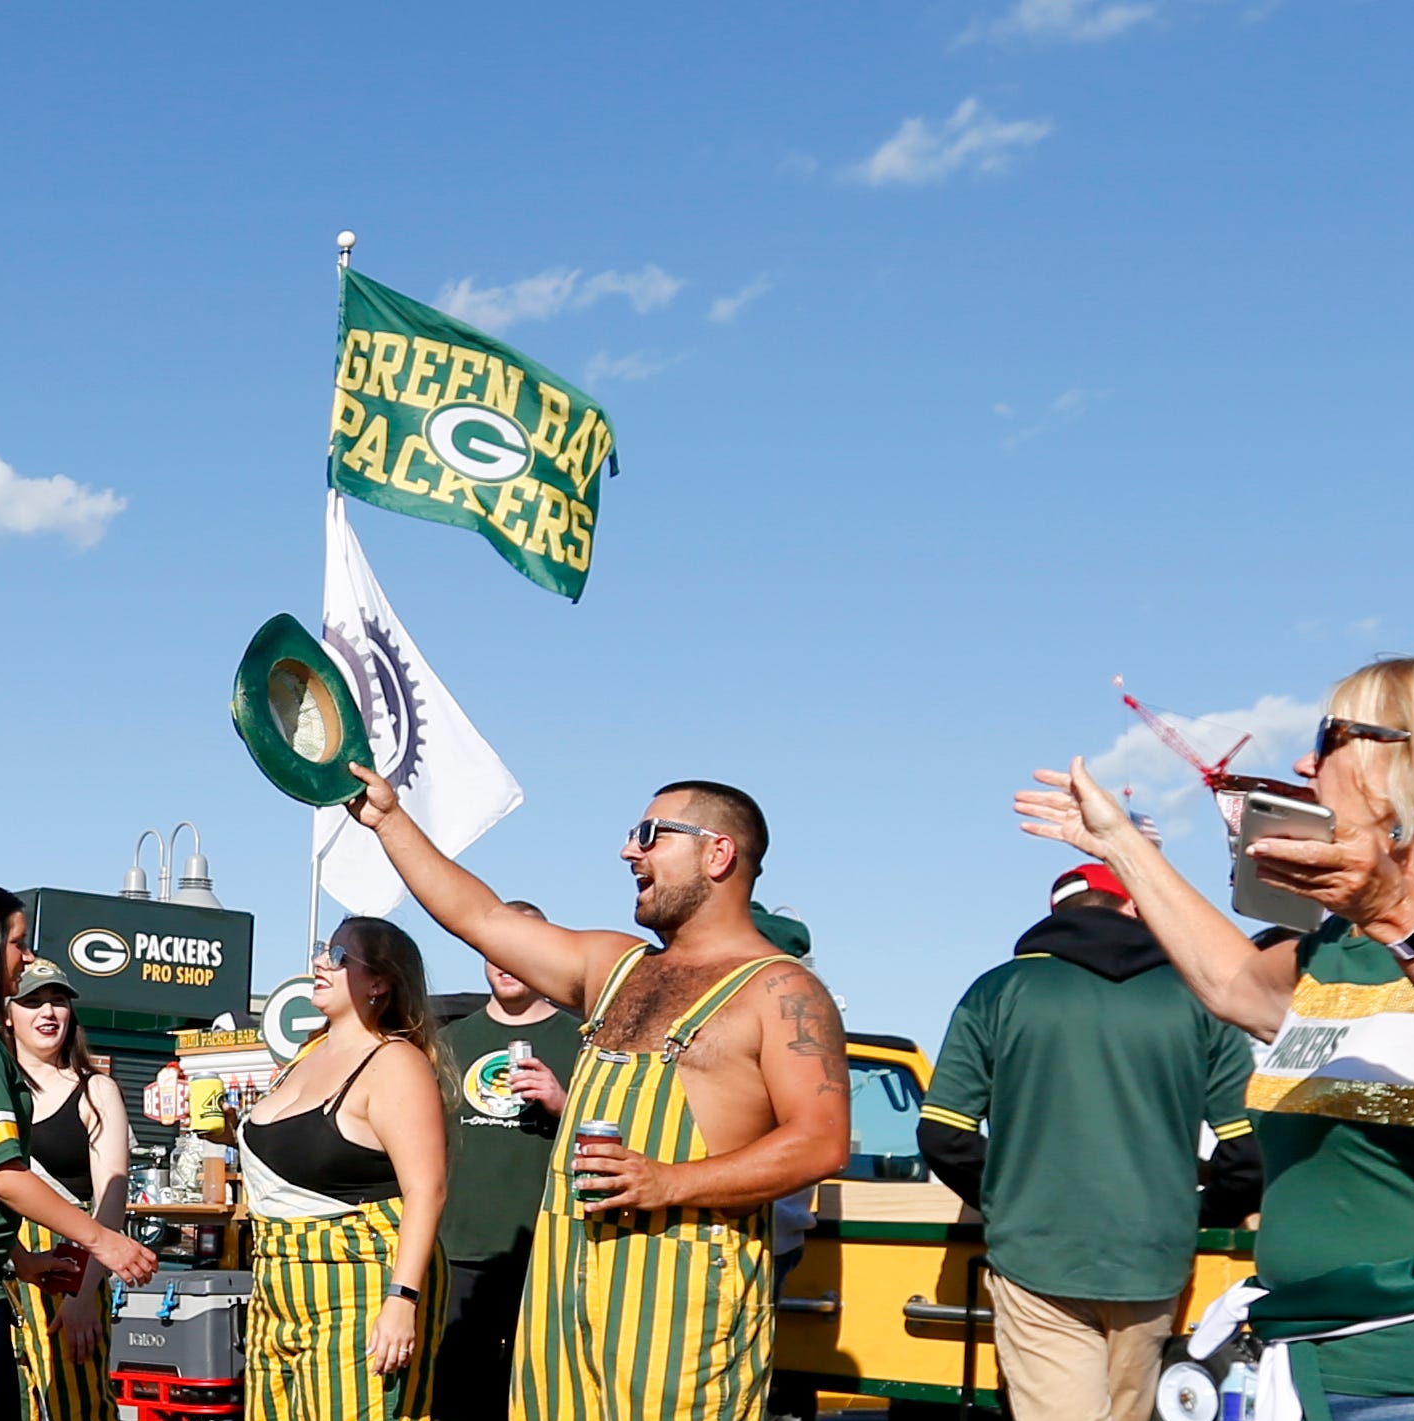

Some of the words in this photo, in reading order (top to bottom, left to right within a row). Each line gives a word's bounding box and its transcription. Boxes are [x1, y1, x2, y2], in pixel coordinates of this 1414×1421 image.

[336, 329, 524, 418] GREEN
[532, 382, 612, 499] BAY
[330, 388, 593, 572] PACKERS
[134, 933, 223, 967] PACKERS
[141, 963, 172, 983] PRO
[176, 966, 214, 986] SHOP
[128, 1332, 166, 1347] IGLOO
